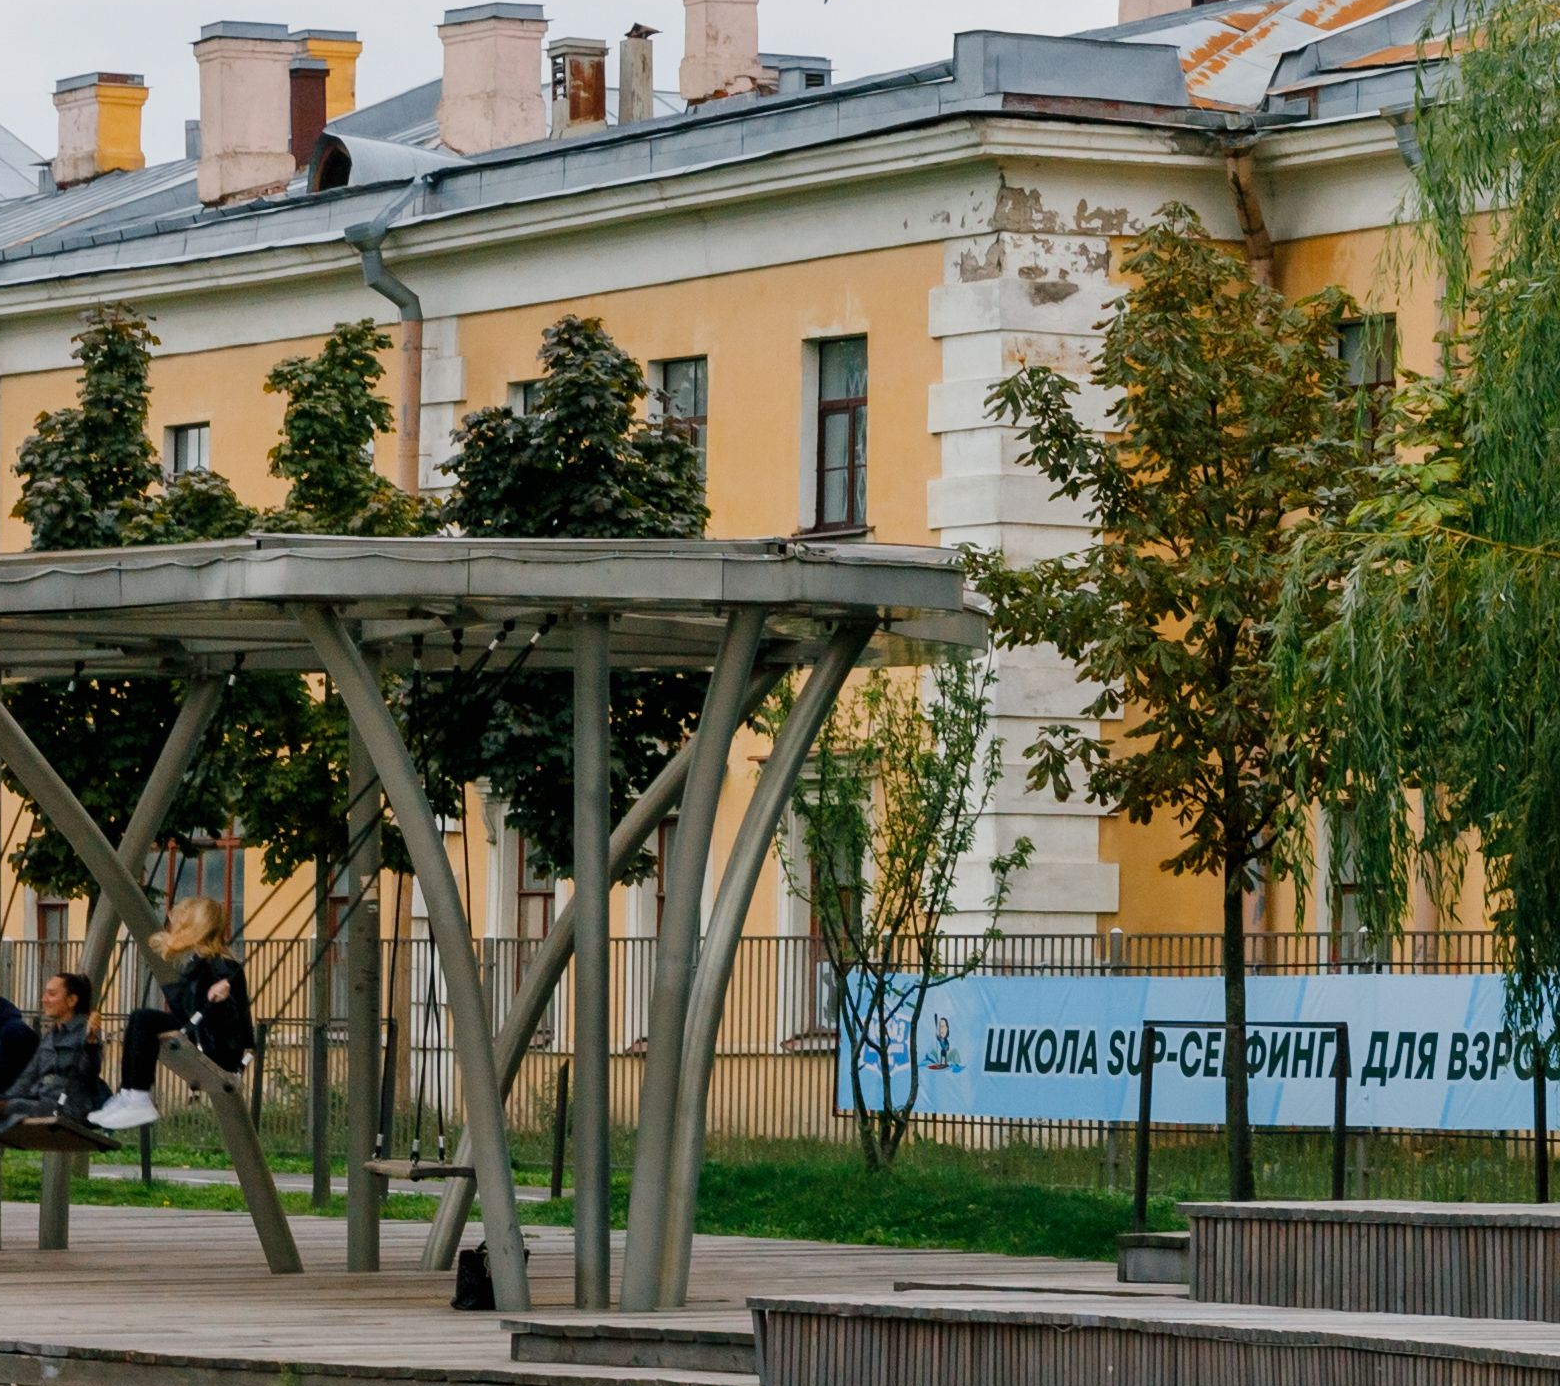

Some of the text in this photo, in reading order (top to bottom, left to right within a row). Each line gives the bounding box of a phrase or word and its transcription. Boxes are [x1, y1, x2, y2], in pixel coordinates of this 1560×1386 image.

[984, 1028, 1098, 1074] ШКОЛА
[1107, 1029, 1352, 1079] SUP-СЕФИНГ
[1360, 1030, 1439, 1087] ДЛЯ
